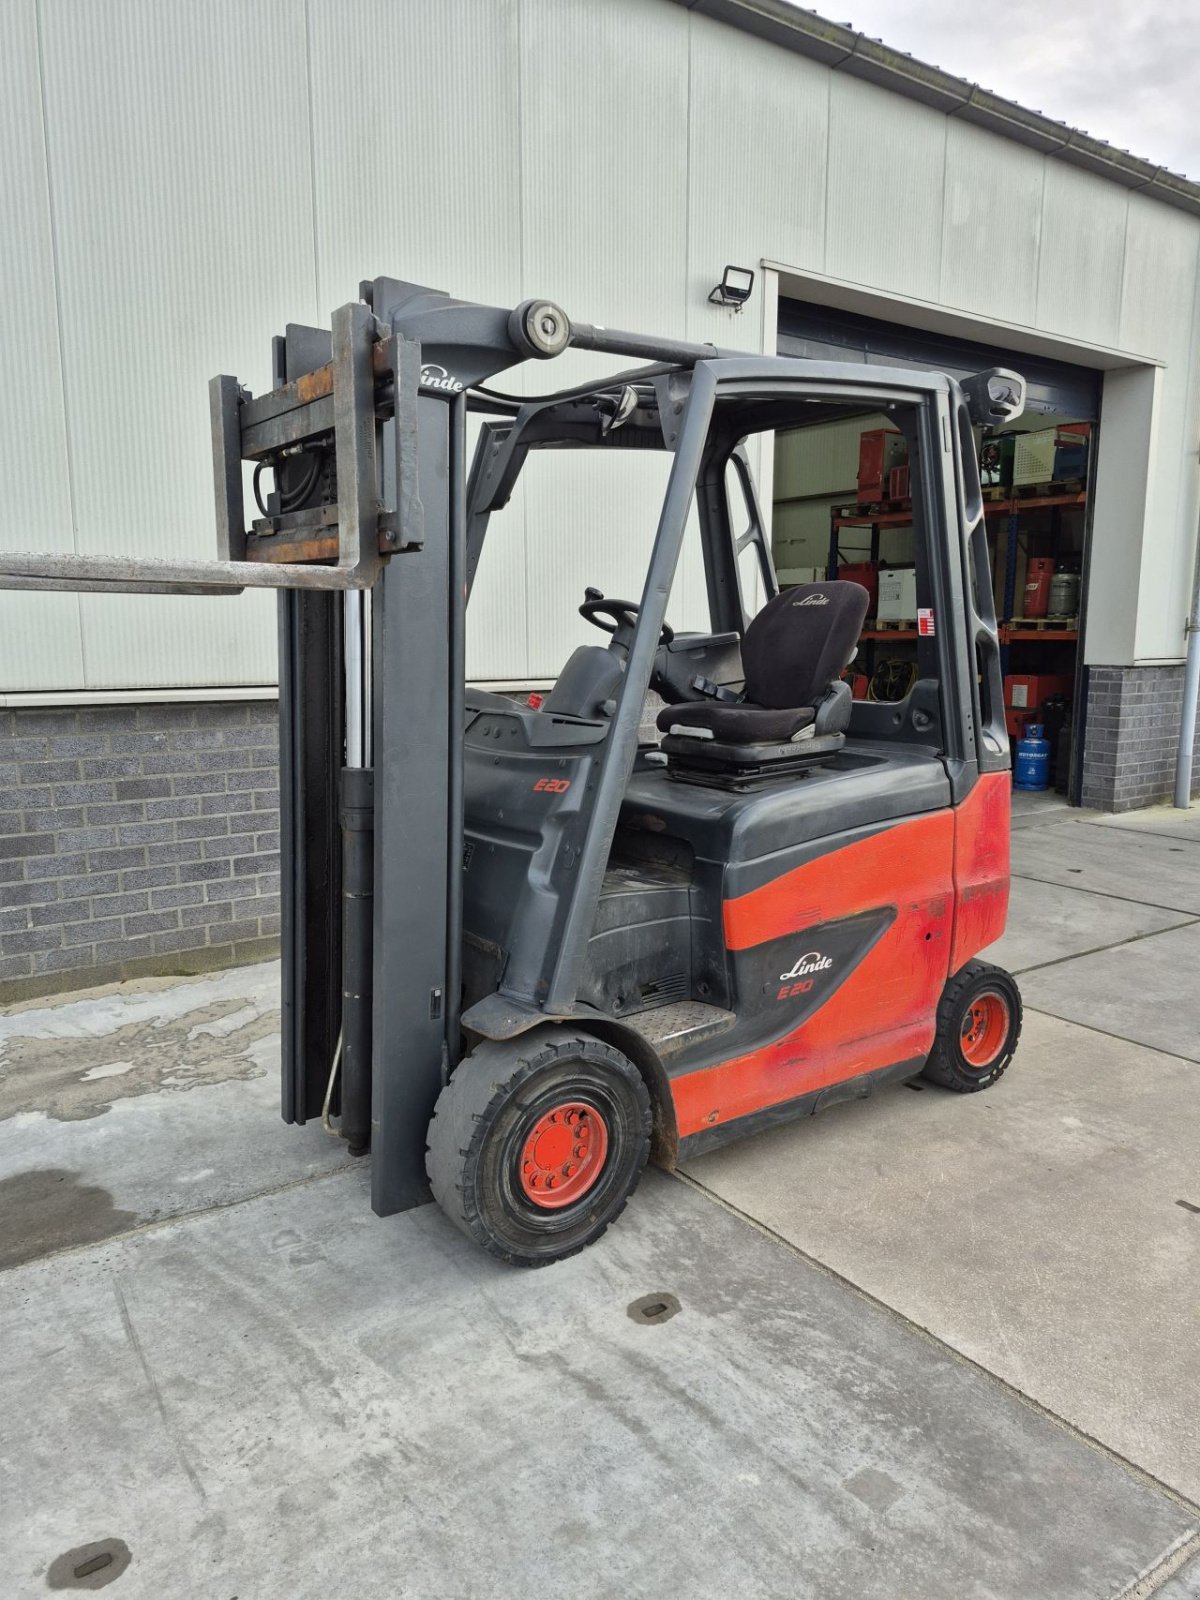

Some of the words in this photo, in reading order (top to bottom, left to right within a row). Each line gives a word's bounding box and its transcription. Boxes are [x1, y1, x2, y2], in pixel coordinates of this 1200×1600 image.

[792, 593, 830, 606] Linde
[533, 778, 571, 793] E20
[779, 952, 833, 980] Linde
[777, 979, 814, 1000] E20
